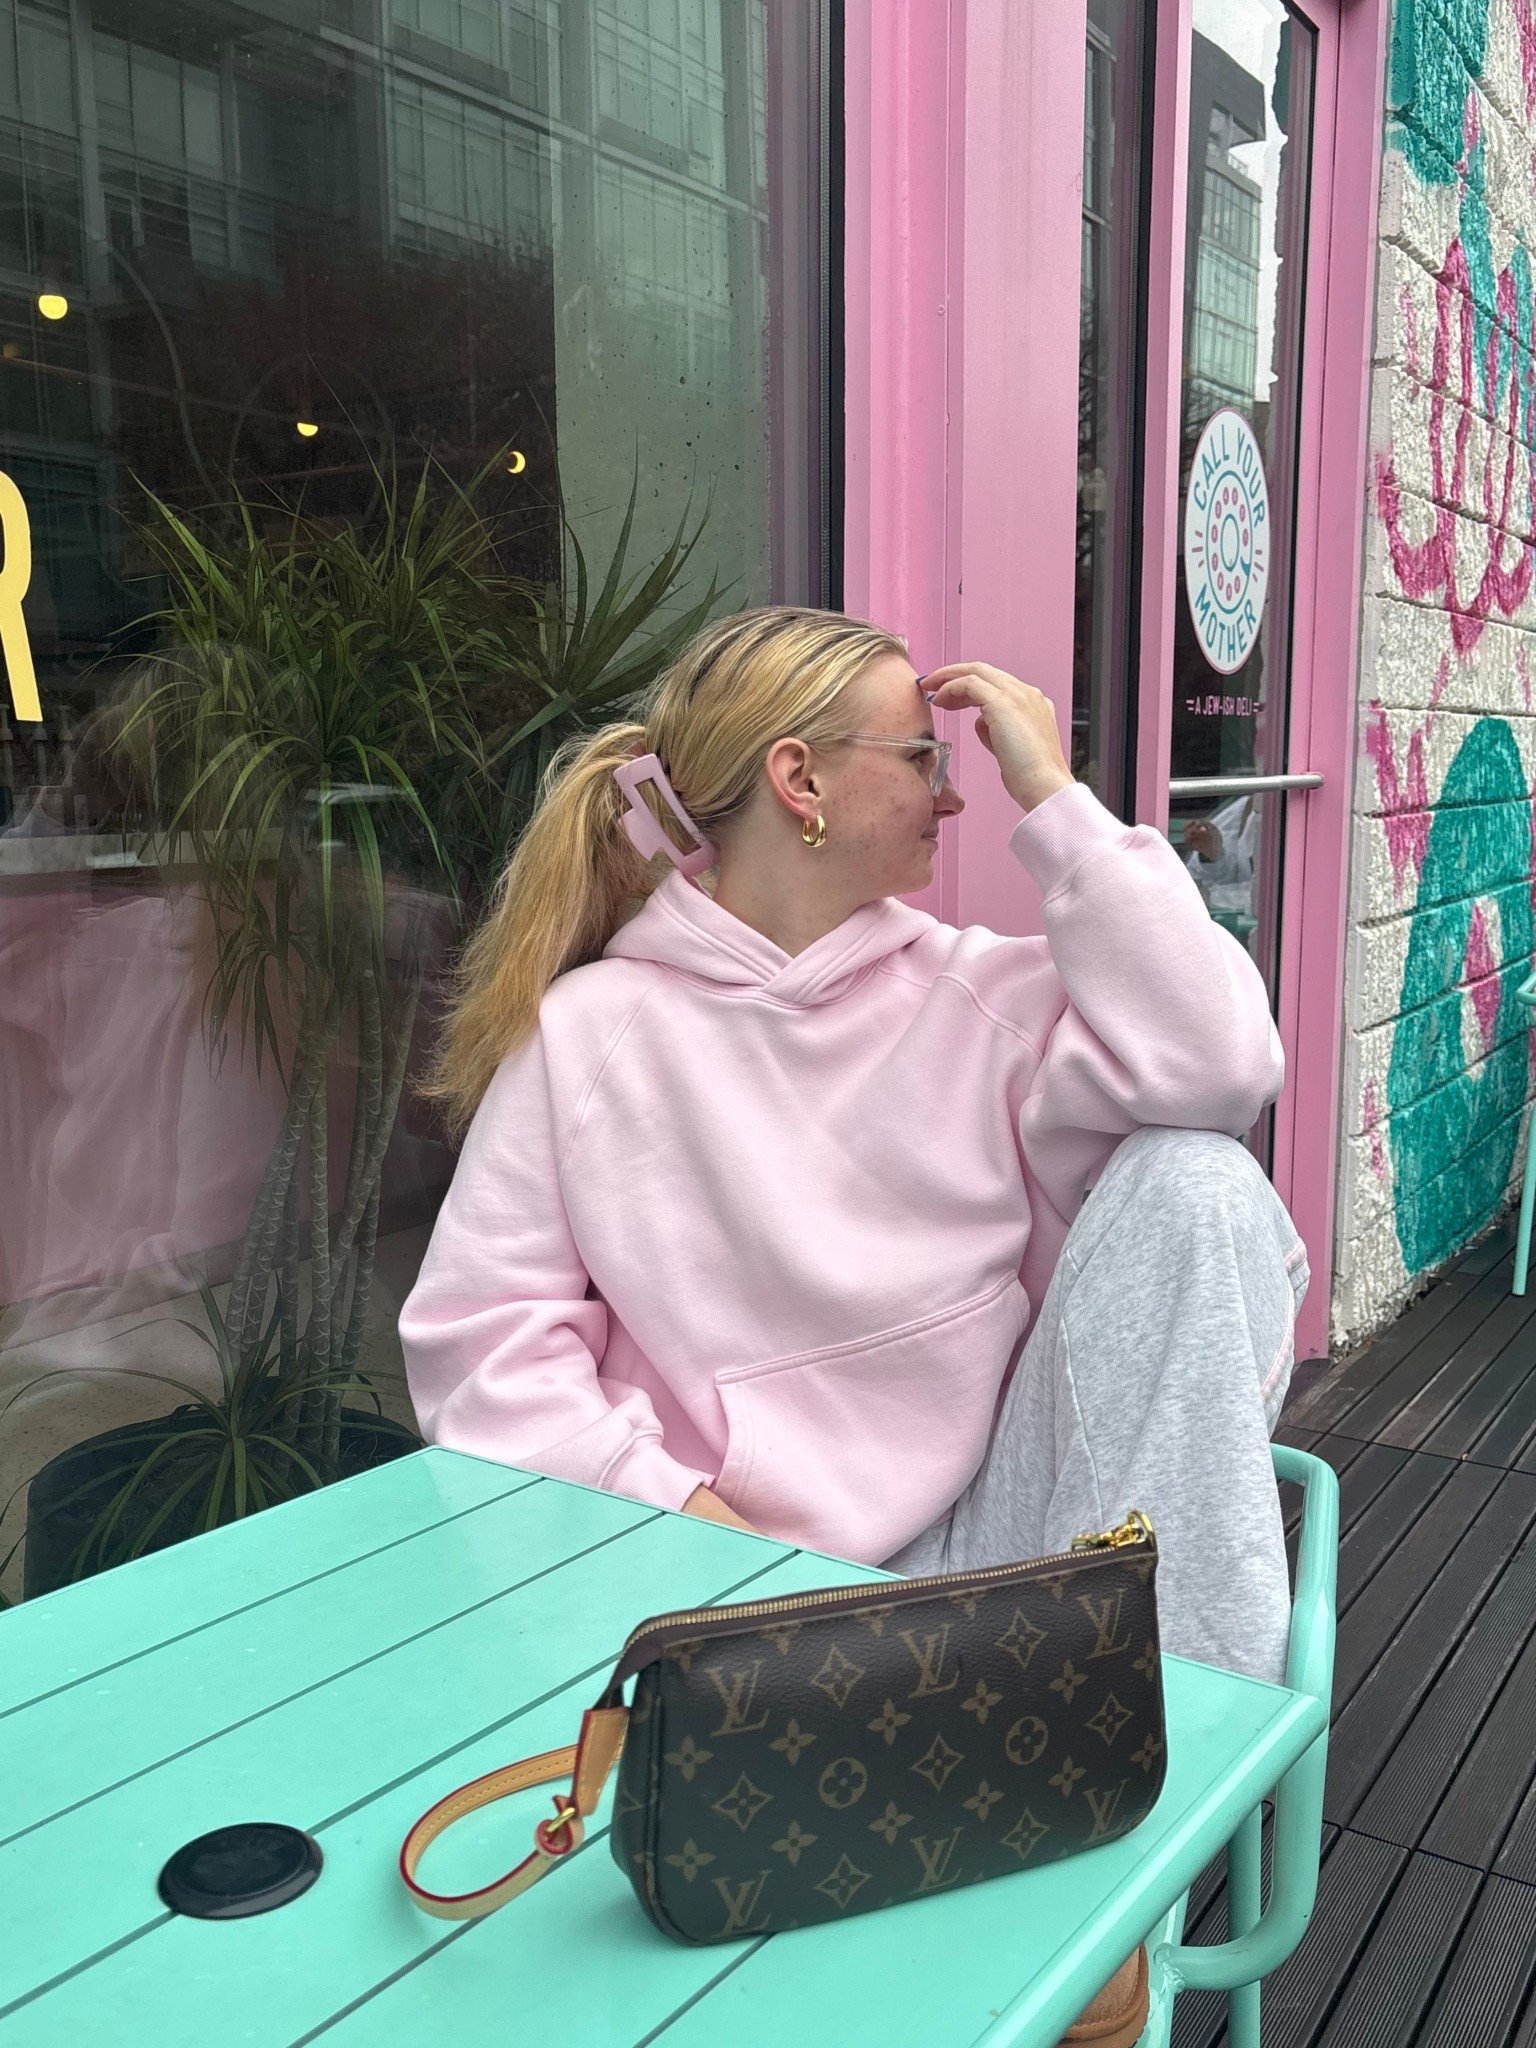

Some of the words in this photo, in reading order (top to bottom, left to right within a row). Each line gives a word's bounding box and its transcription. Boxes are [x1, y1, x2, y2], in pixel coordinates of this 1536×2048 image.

[1194, 424, 1230, 511] CALL
[1236, 427, 1265, 528] YOUR
[1195, 583, 1257, 663] MOTHER
[1195, 695, 1201, 715] A
[1236, 697, 1253, 716] DELI
